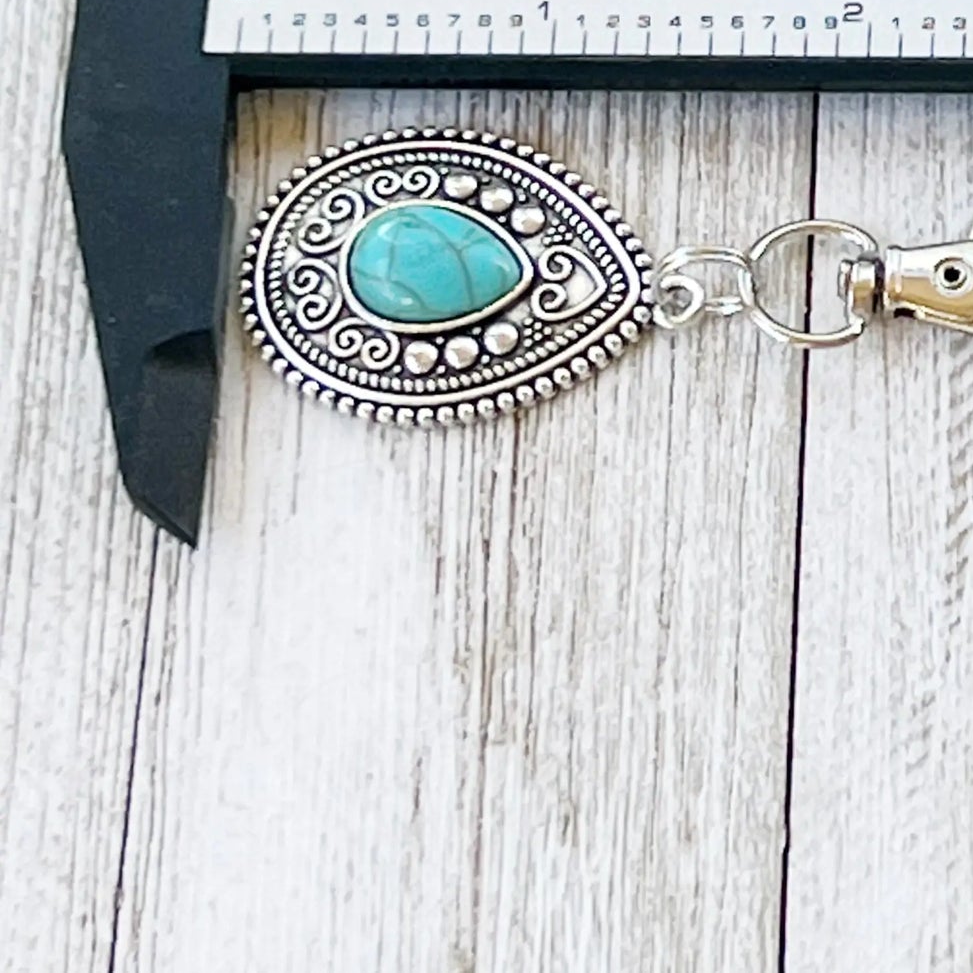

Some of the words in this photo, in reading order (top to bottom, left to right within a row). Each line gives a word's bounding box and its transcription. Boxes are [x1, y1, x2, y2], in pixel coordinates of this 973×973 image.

[264, 13, 272, 25] 1
[292, 13, 307, 26] 2
[323, 13, 337, 27] 3
[354, 14, 367, 26] 4
[386, 14, 399, 27] 5
[417, 14, 430, 27] 6
[448, 14, 461, 27] 7
[478, 14, 492, 27] 8
[510, 14, 523, 27] 9
[538, 1, 549, 21] 1
[577, 15, 585, 27] 1
[606, 15, 620, 28] 2
[637, 15, 651, 28] 3
[669, 16, 682, 27] 4
[700, 16, 713, 28] 5
[731, 16, 744, 29] 6
[762, 16, 775, 29] 7
[793, 16, 806, 30] 8
[825, 16, 838, 30] 9
[842, 2, 864, 22] 2
[892, 17, 900, 28] 1
[921, 17, 936, 30] 2
[952, 17, 966, 30] 3
